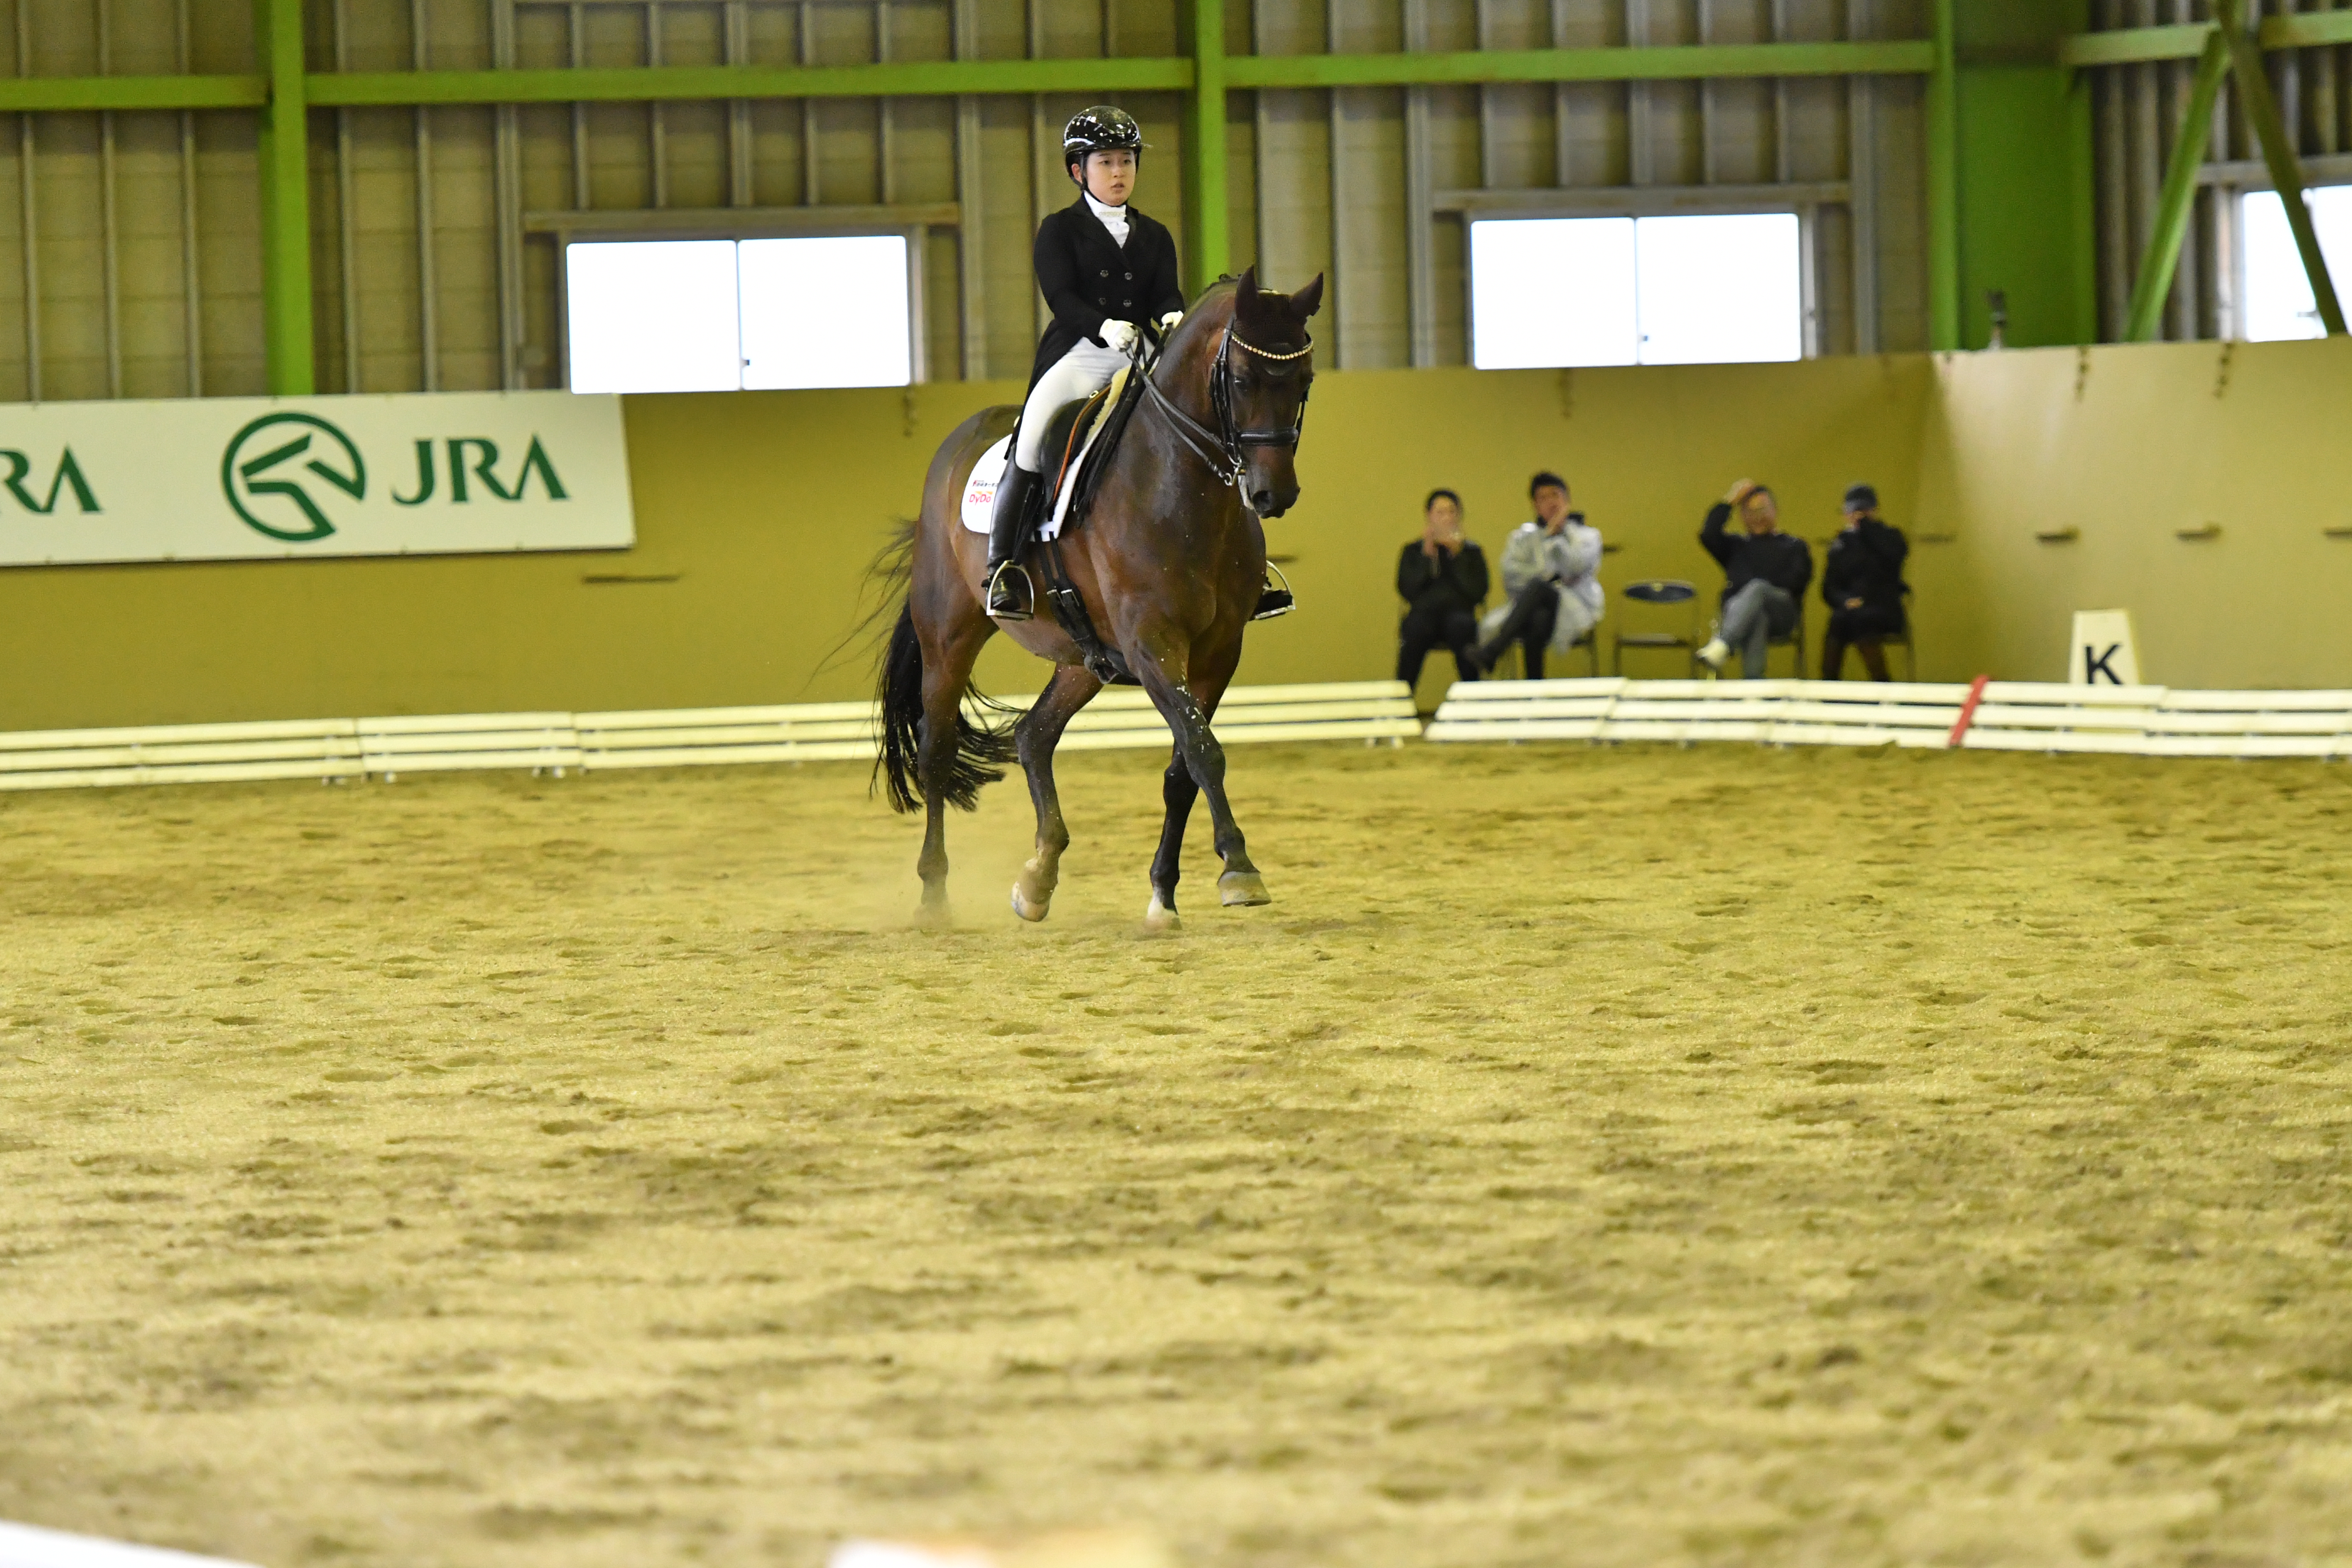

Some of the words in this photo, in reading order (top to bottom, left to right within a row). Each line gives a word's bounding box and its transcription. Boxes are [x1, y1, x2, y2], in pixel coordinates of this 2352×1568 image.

[391, 432, 569, 506] JRA
[969, 494, 991, 505] DyDo
[2085, 644, 2122, 684] K
